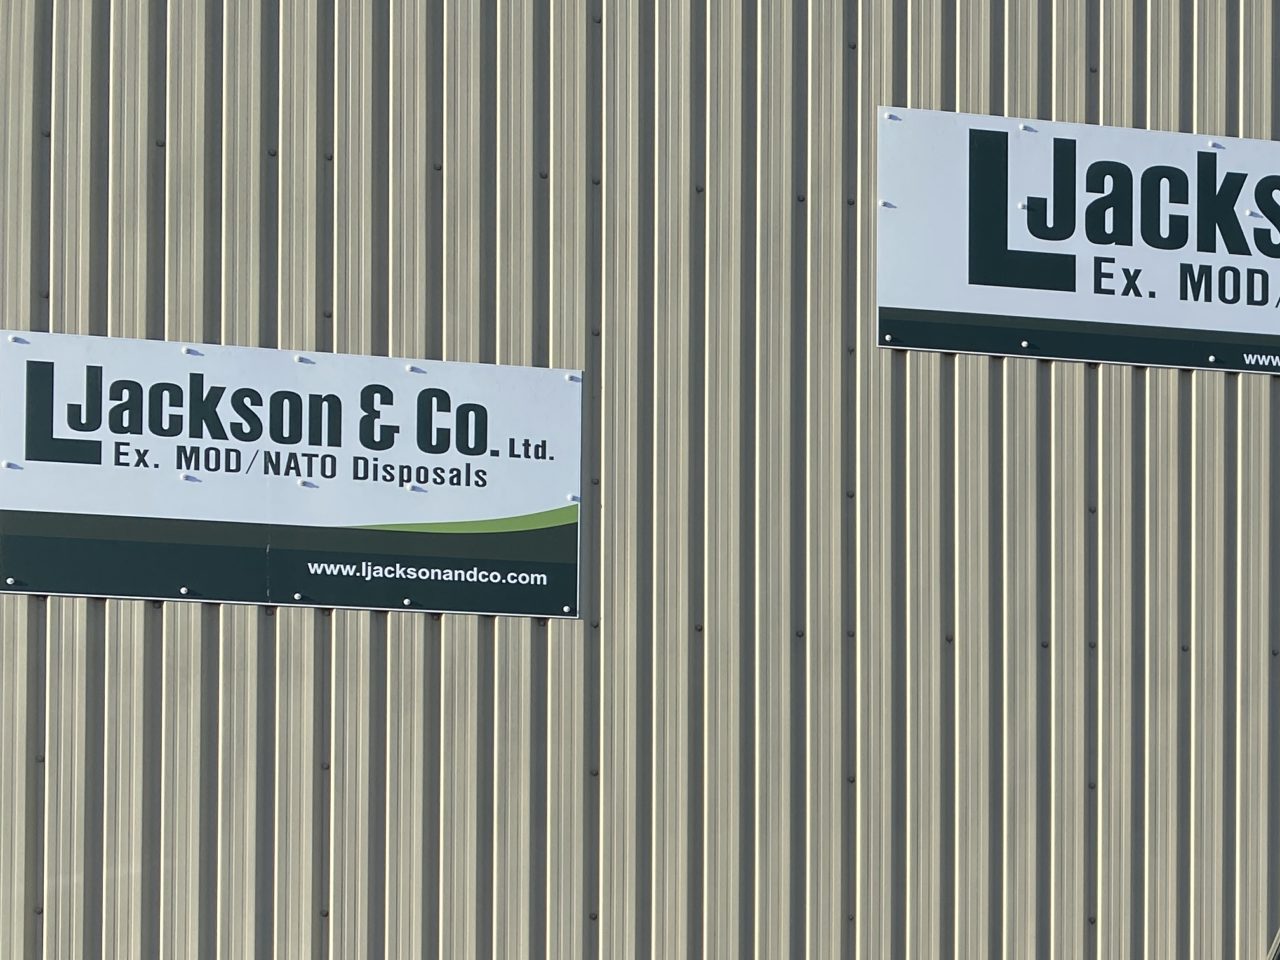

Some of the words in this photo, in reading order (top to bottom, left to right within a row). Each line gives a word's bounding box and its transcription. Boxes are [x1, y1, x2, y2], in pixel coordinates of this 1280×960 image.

[1094, 257, 1156, 299] Ex.
[359, 384, 400, 452] &
[417, 388, 500, 458] Co.
[509, 438, 554, 461] Ltd.
[115, 442, 159, 470] Ex.
[176, 446, 337, 480] MOD/NATO
[353, 456, 488, 490] Disposals
[308, 562, 547, 586] www.ljacksonandco.com
